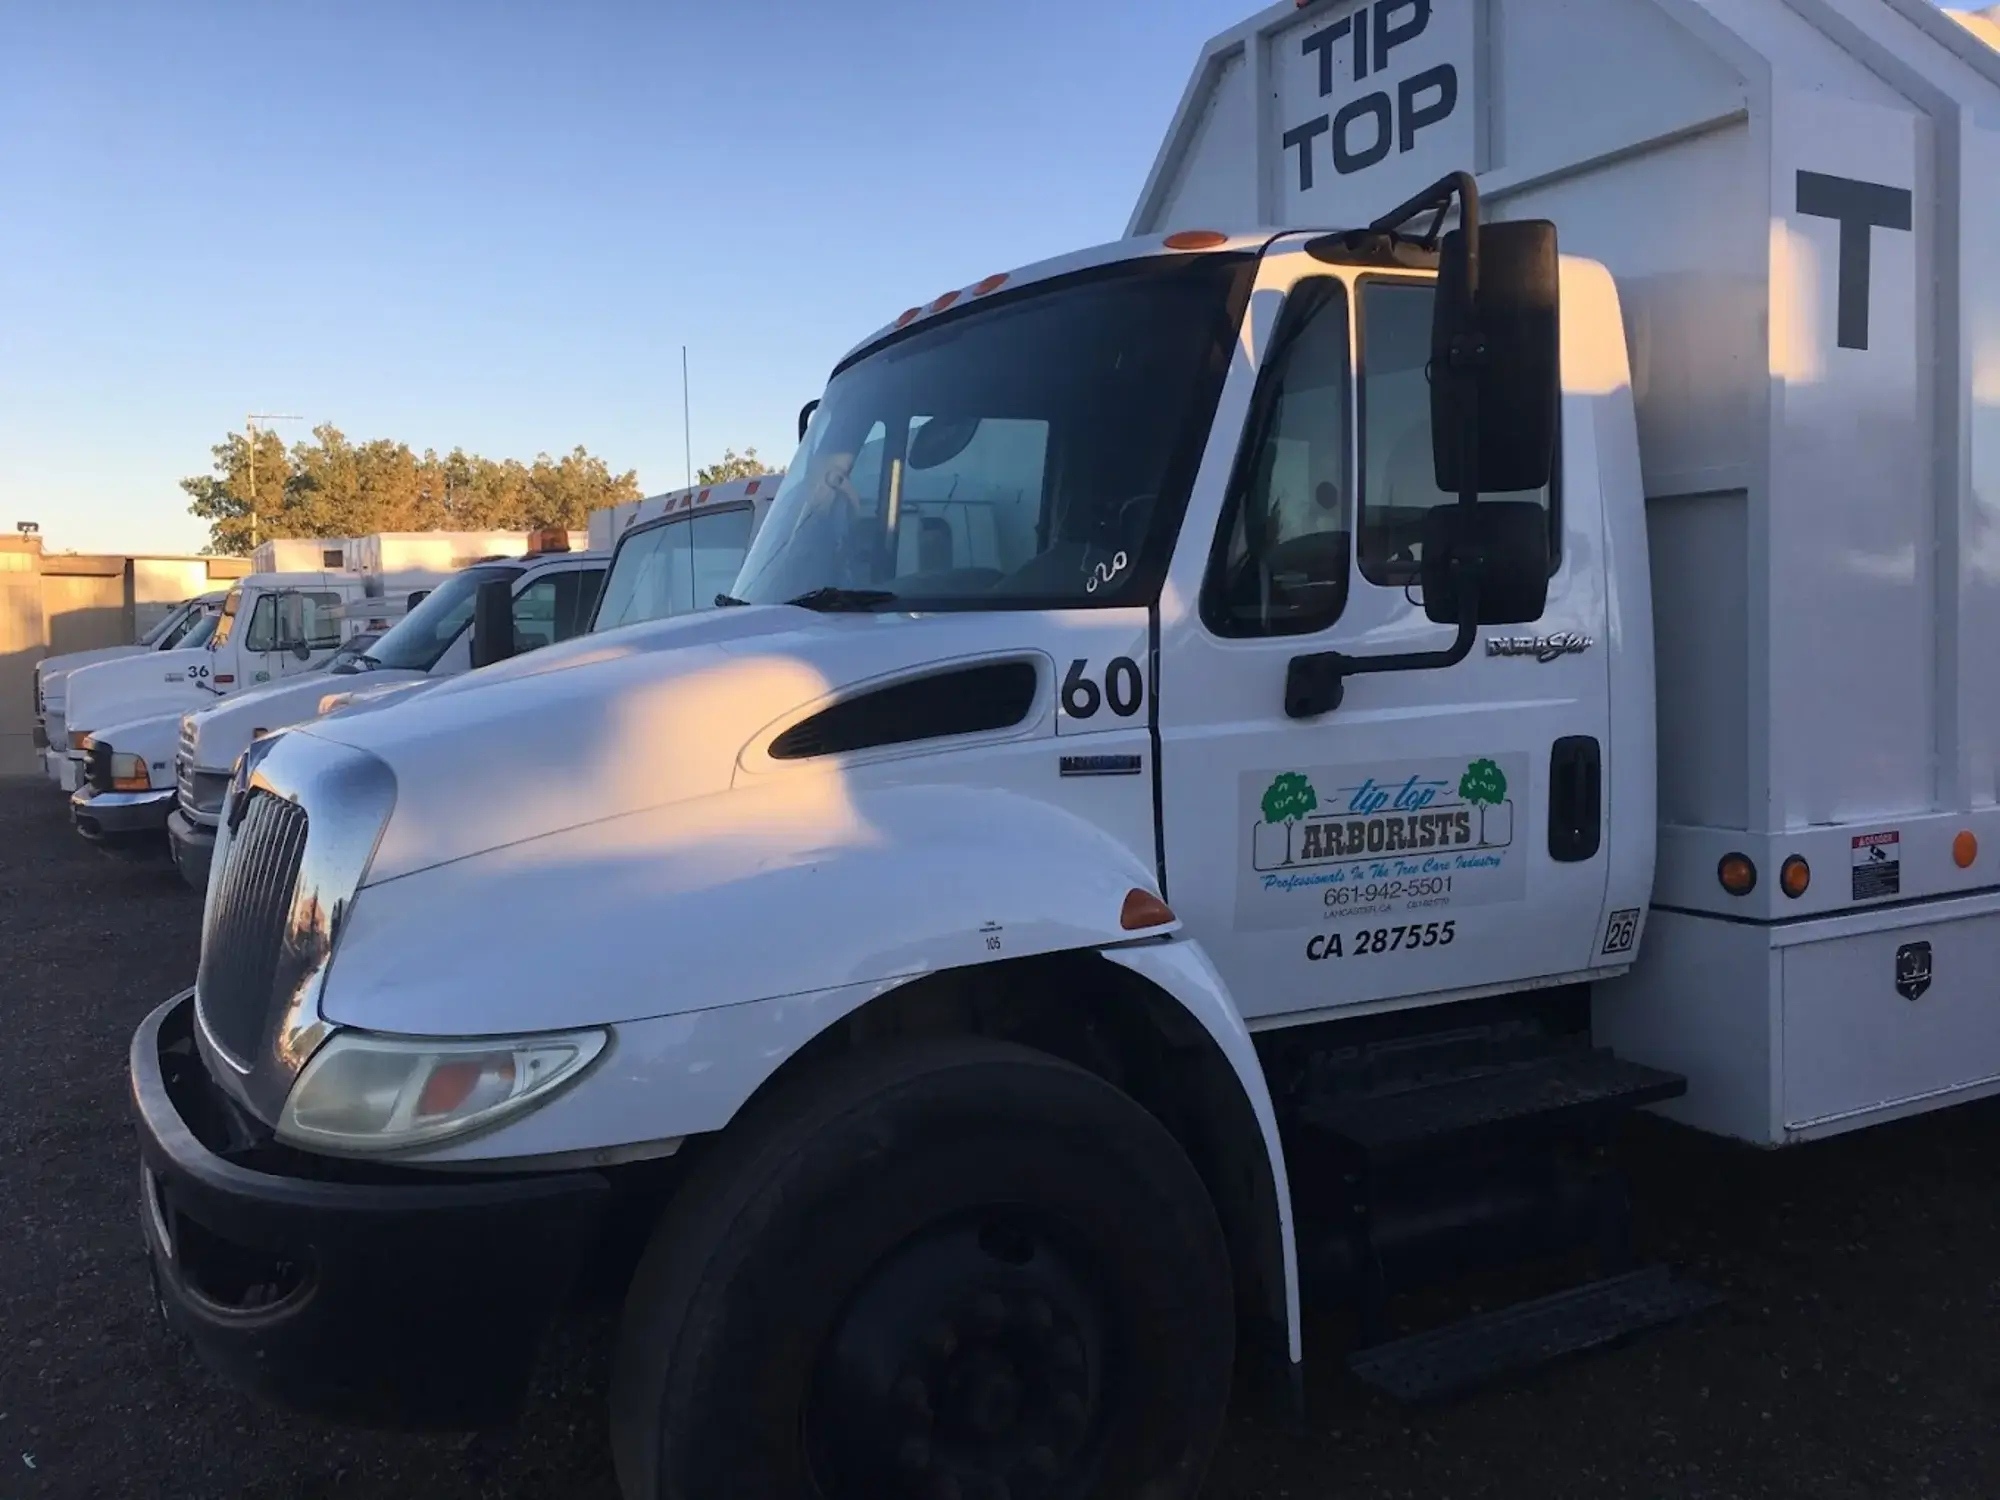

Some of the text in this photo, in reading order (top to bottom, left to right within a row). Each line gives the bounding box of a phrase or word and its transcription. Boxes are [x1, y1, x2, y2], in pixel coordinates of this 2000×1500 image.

[1302, 0, 1430, 97] TIP
[1283, 63, 1457, 192] TOP
[1796, 169, 1912, 351] T
[187, 665, 210, 678] 36
[1061, 656, 1143, 719] 60
[1301, 810, 1470, 860] ARBORISTS
[1350, 866, 1364, 880] In
[1369, 863, 1389, 879] The
[1393, 860, 1419, 878] Tree
[1422, 856, 1451, 874] Care
[1324, 875, 1452, 907] 661-942-5501
[985, 936, 1001, 950] 105
[1306, 920, 1456, 961] CA 287555
[1607, 920, 1633, 949] 26
